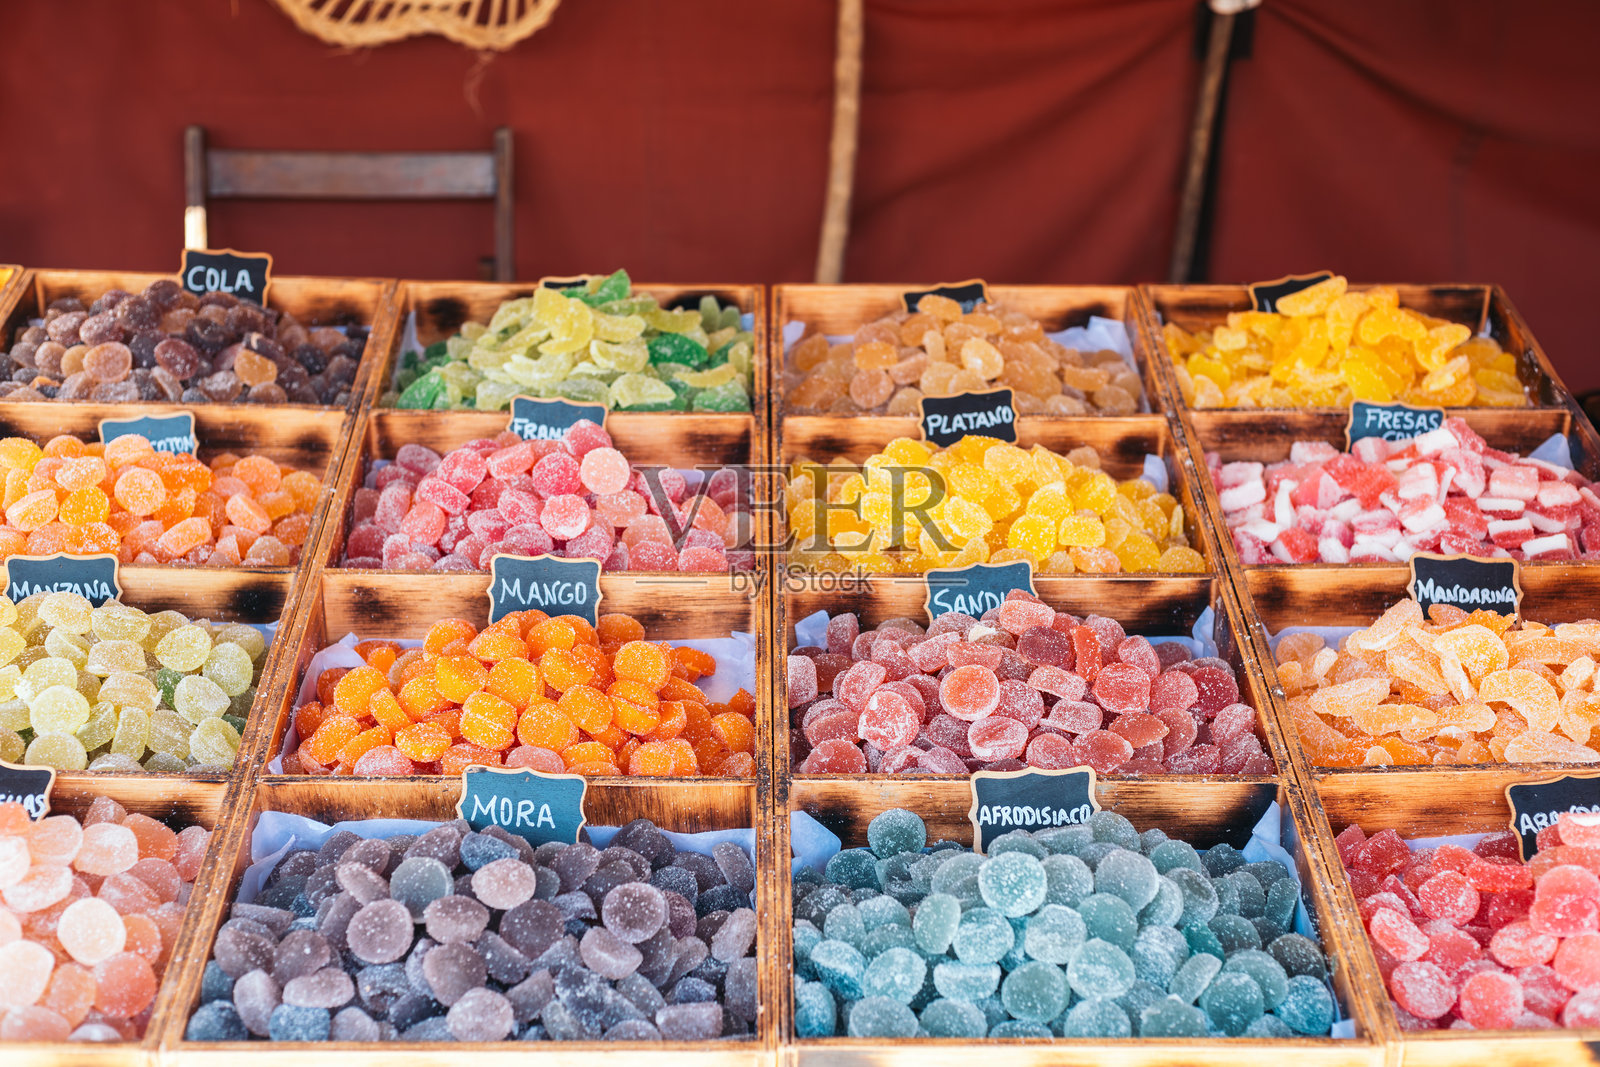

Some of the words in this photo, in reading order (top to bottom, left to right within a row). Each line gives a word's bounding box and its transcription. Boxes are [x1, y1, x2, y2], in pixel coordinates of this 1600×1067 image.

[187, 265, 254, 293] COLA
[926, 405, 1013, 436] PLATANO
[1365, 408, 1439, 431] FRESAS
[499, 577, 587, 607] MANGO
[1416, 577, 1518, 606] MANDARINA
[470, 794, 556, 829] MORA
[979, 804, 1091, 826] AFRODISIACO
